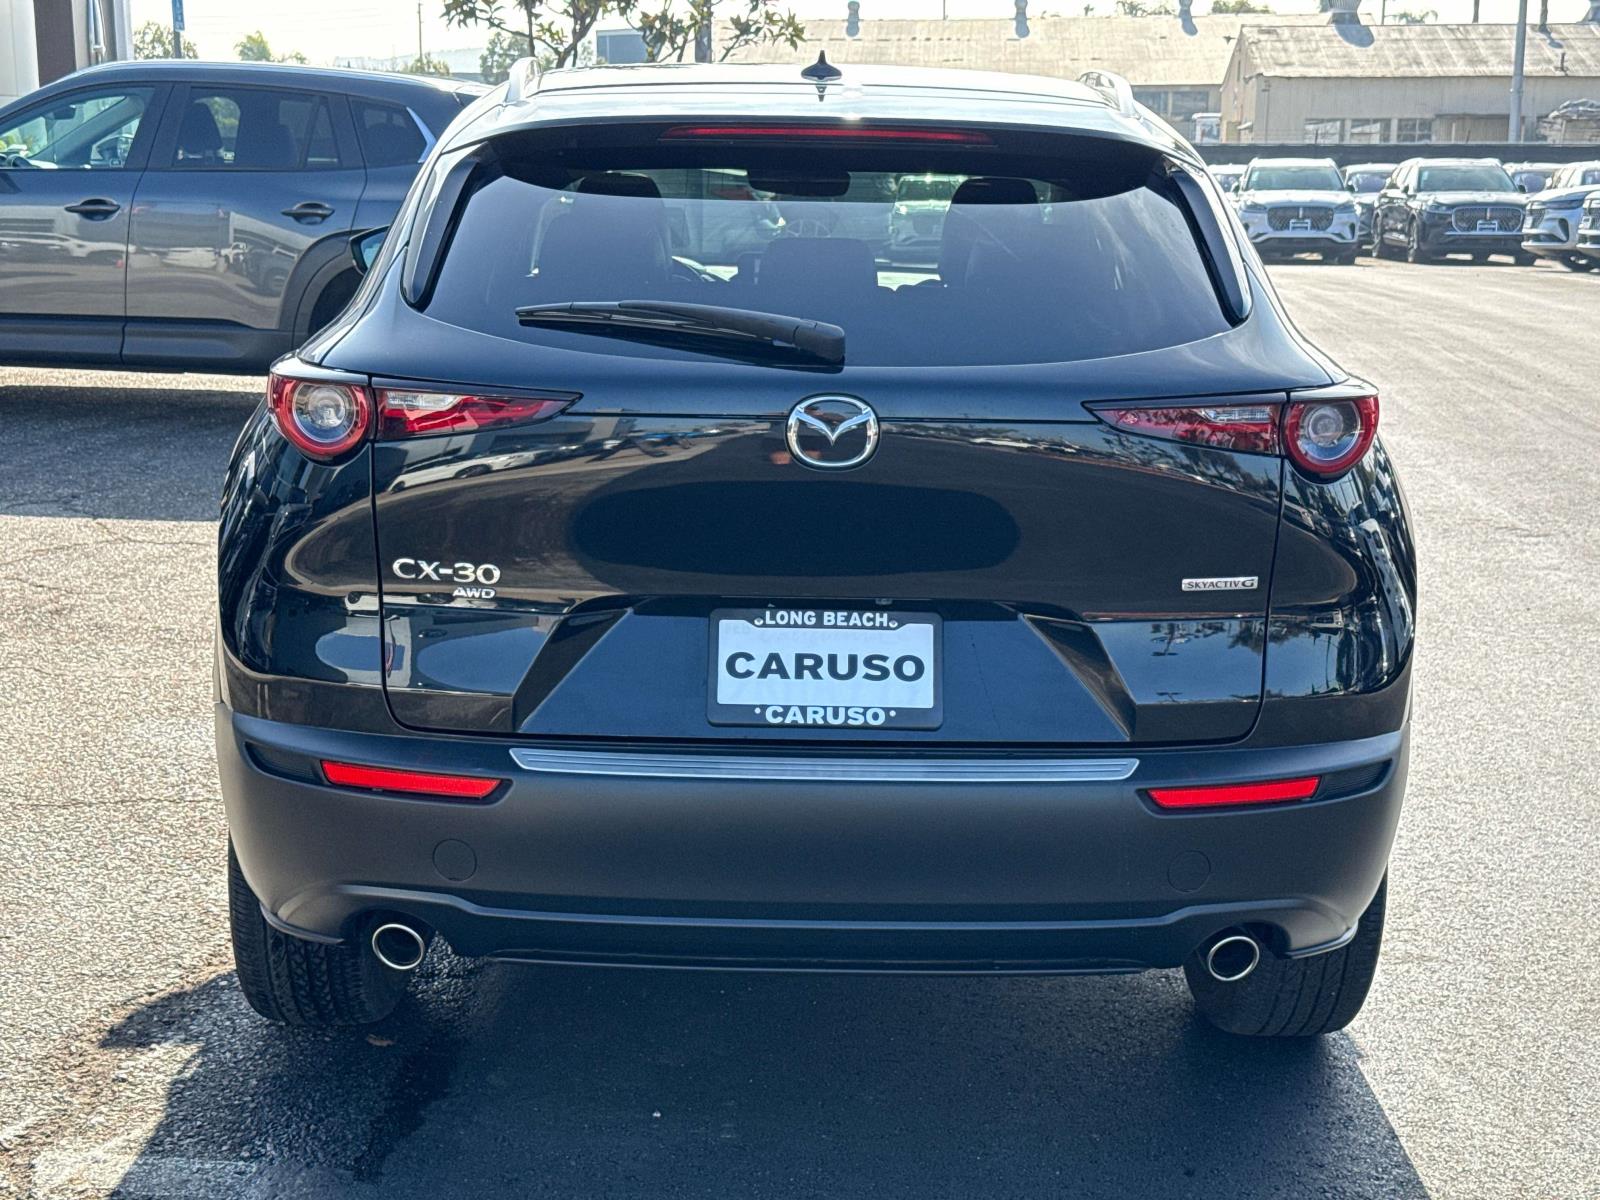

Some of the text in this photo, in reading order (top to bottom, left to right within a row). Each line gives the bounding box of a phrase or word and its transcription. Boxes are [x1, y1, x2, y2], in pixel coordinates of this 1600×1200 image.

[392, 558, 500, 585] CX-30
[453, 587, 496, 599] AWD
[765, 610, 888, 627] LONG BEACH
[726, 651, 925, 682] CARUSO
[765, 705, 886, 725] CARUSO
